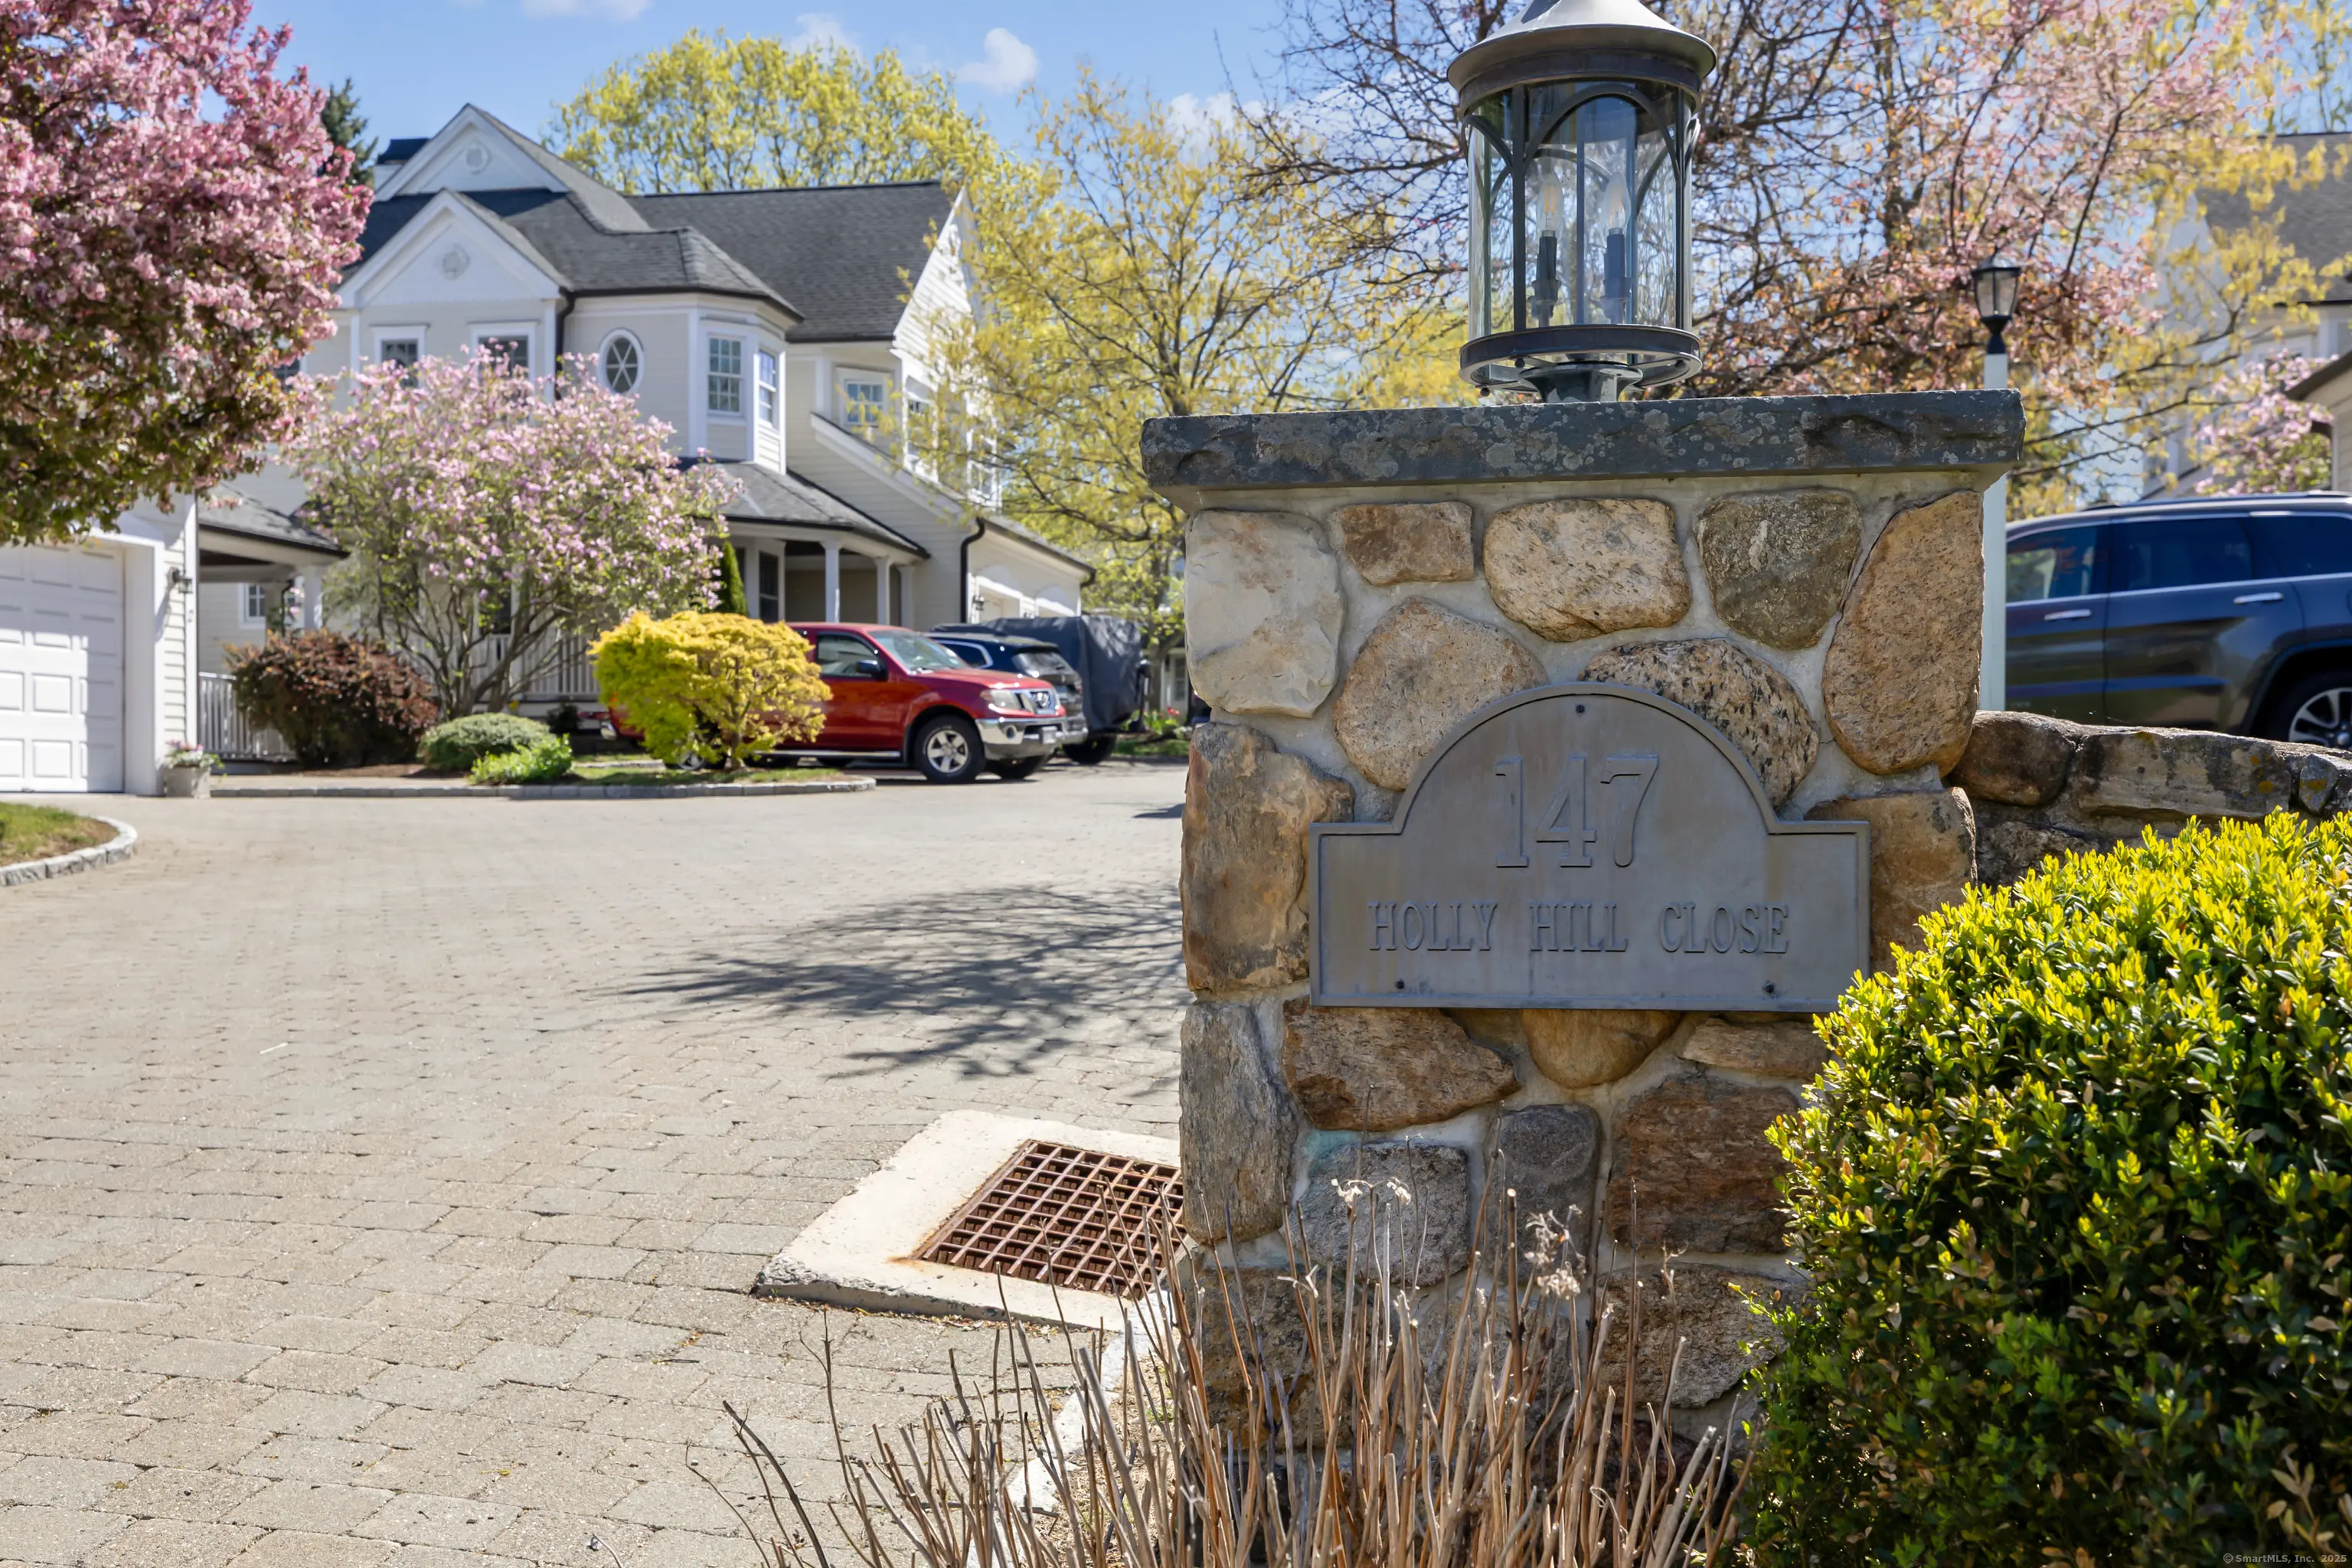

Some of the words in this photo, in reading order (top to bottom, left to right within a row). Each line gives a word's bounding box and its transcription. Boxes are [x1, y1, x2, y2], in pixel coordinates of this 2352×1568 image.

[1495, 753, 1659, 867] 147
[1367, 900, 1498, 952] HOLLY
[1530, 900, 1628, 952] HILL
[1659, 902, 1788, 954] CLOSE
